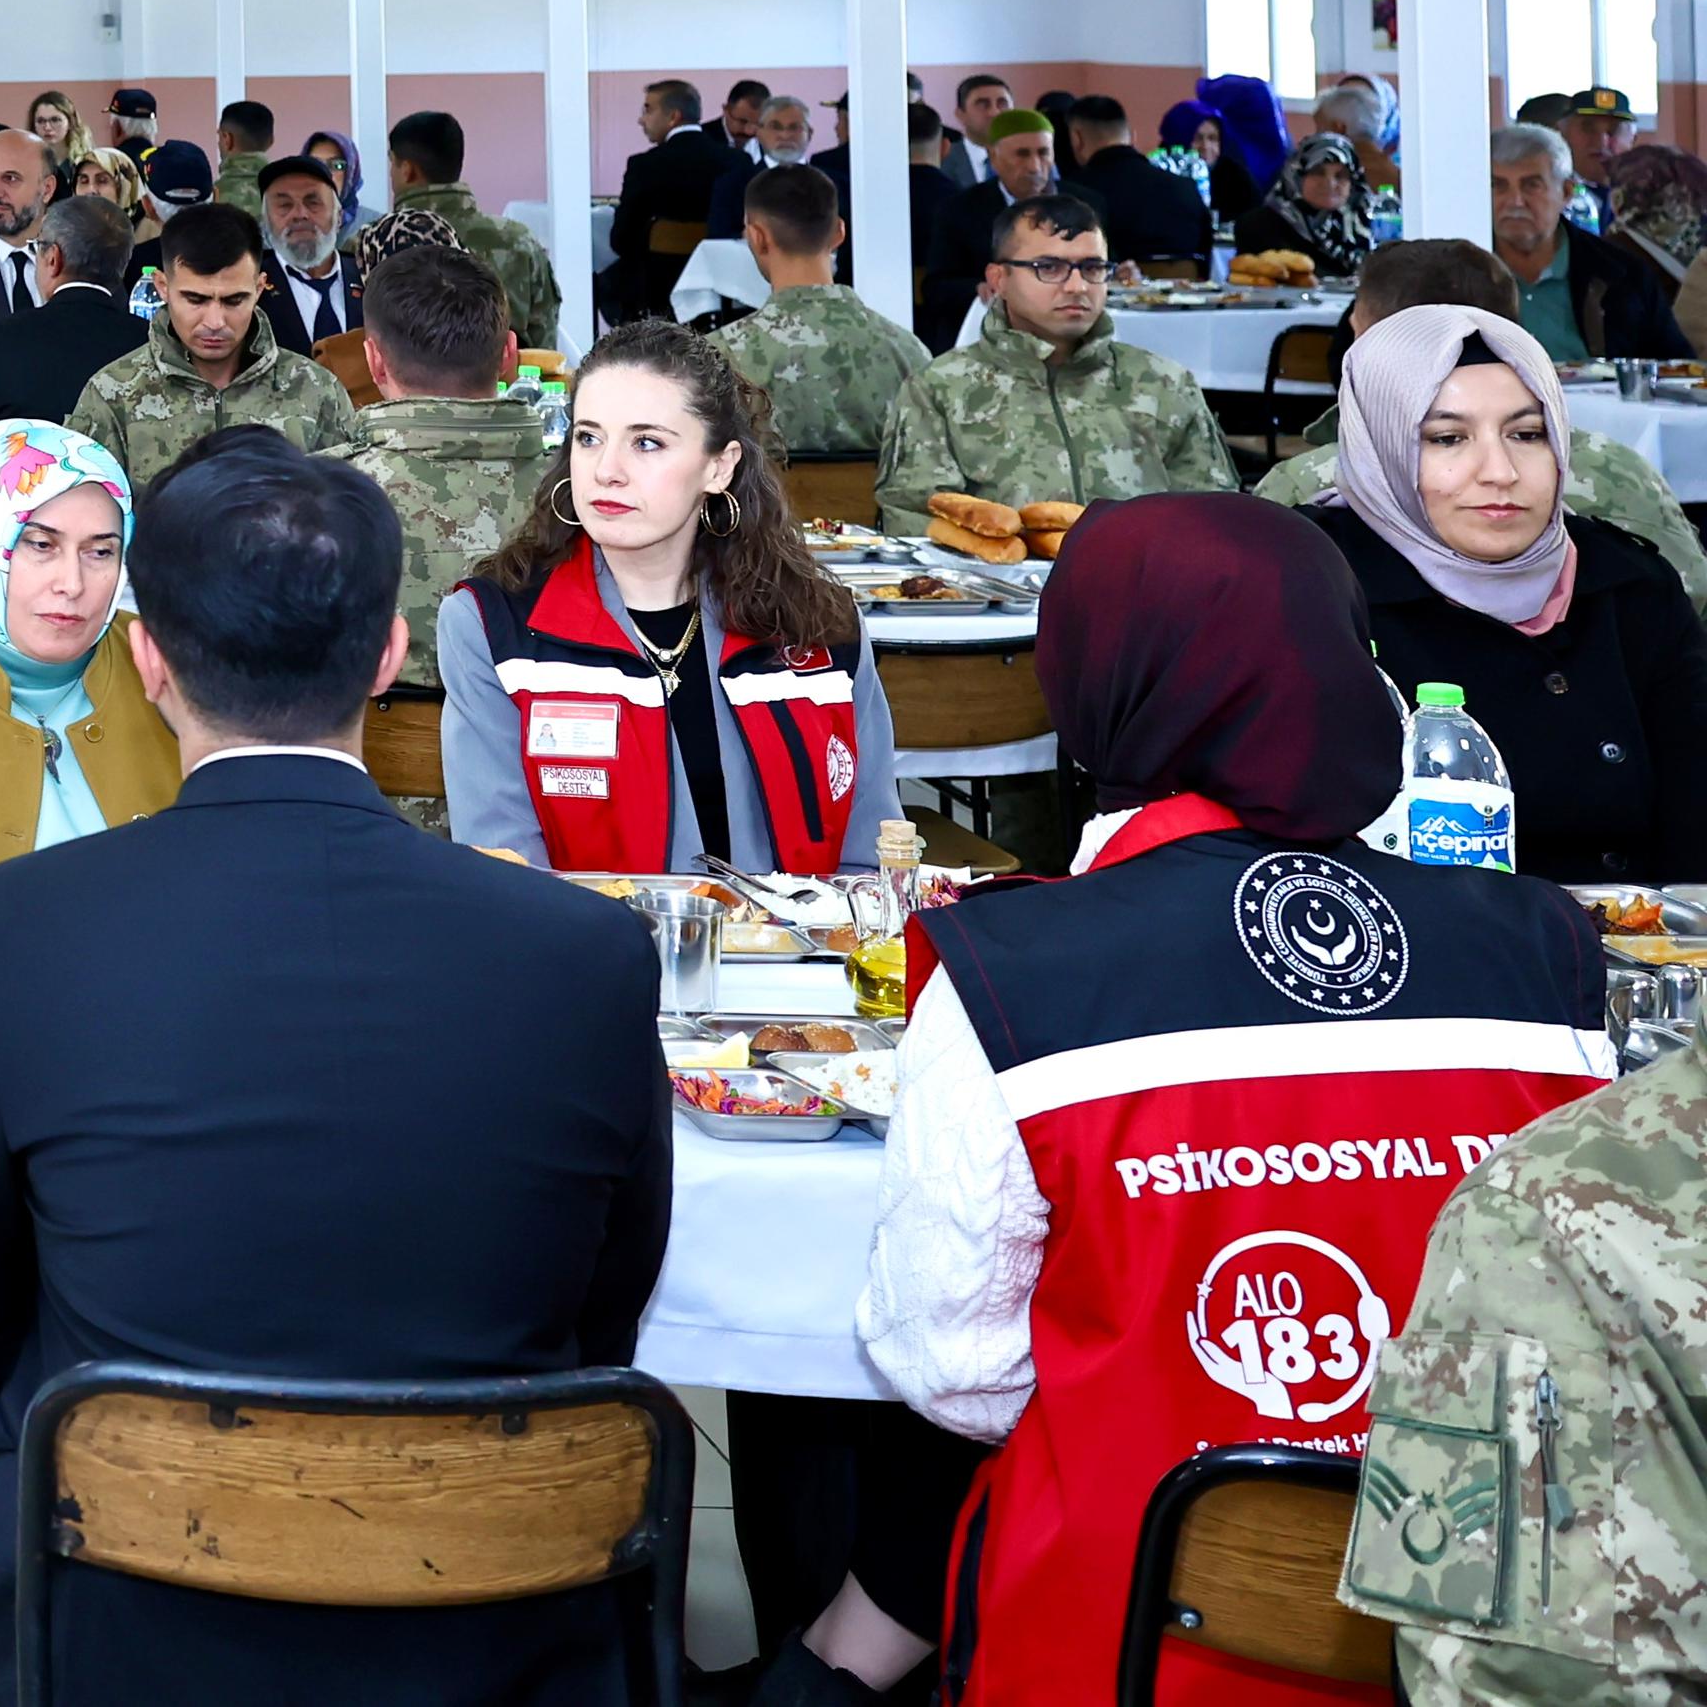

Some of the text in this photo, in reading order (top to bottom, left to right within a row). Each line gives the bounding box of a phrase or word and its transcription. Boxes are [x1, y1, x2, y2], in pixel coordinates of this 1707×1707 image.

[558, 782, 593, 795] DESTEK
[1306, 878, 1343, 897] SOSYAL
[1114, 1137, 1447, 1199] PSİKOSOSYAL
[1235, 1271, 1303, 1318] ALO
[1221, 1313, 1360, 1385] 183
